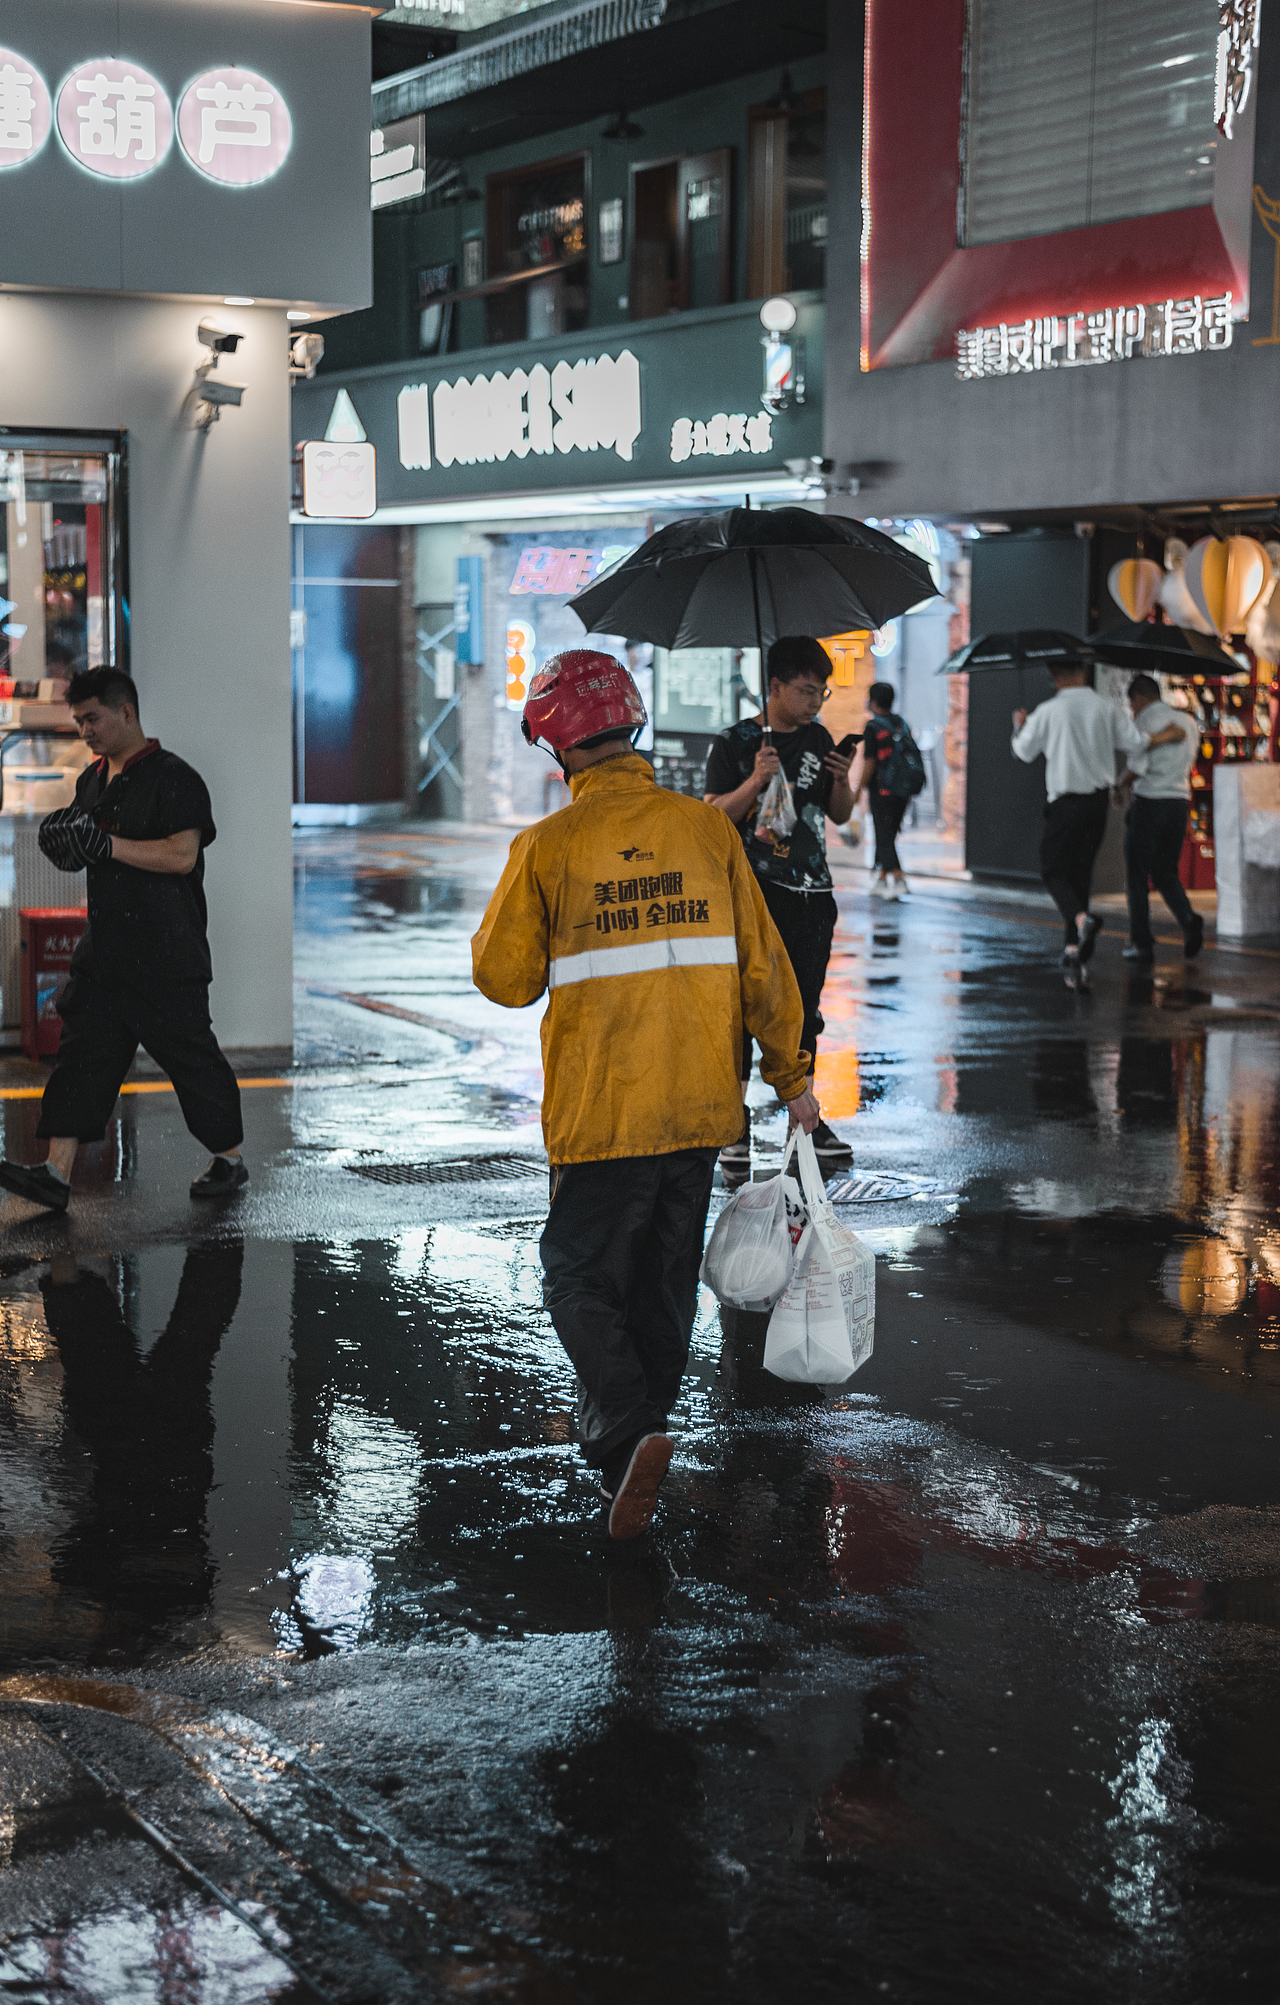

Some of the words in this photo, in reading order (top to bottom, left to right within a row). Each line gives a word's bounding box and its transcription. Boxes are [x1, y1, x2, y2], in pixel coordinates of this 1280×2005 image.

[593, 871, 683, 906] 美团跑腿
[573, 906, 639, 935] 一小时
[646, 899, 709, 928] 全城送
